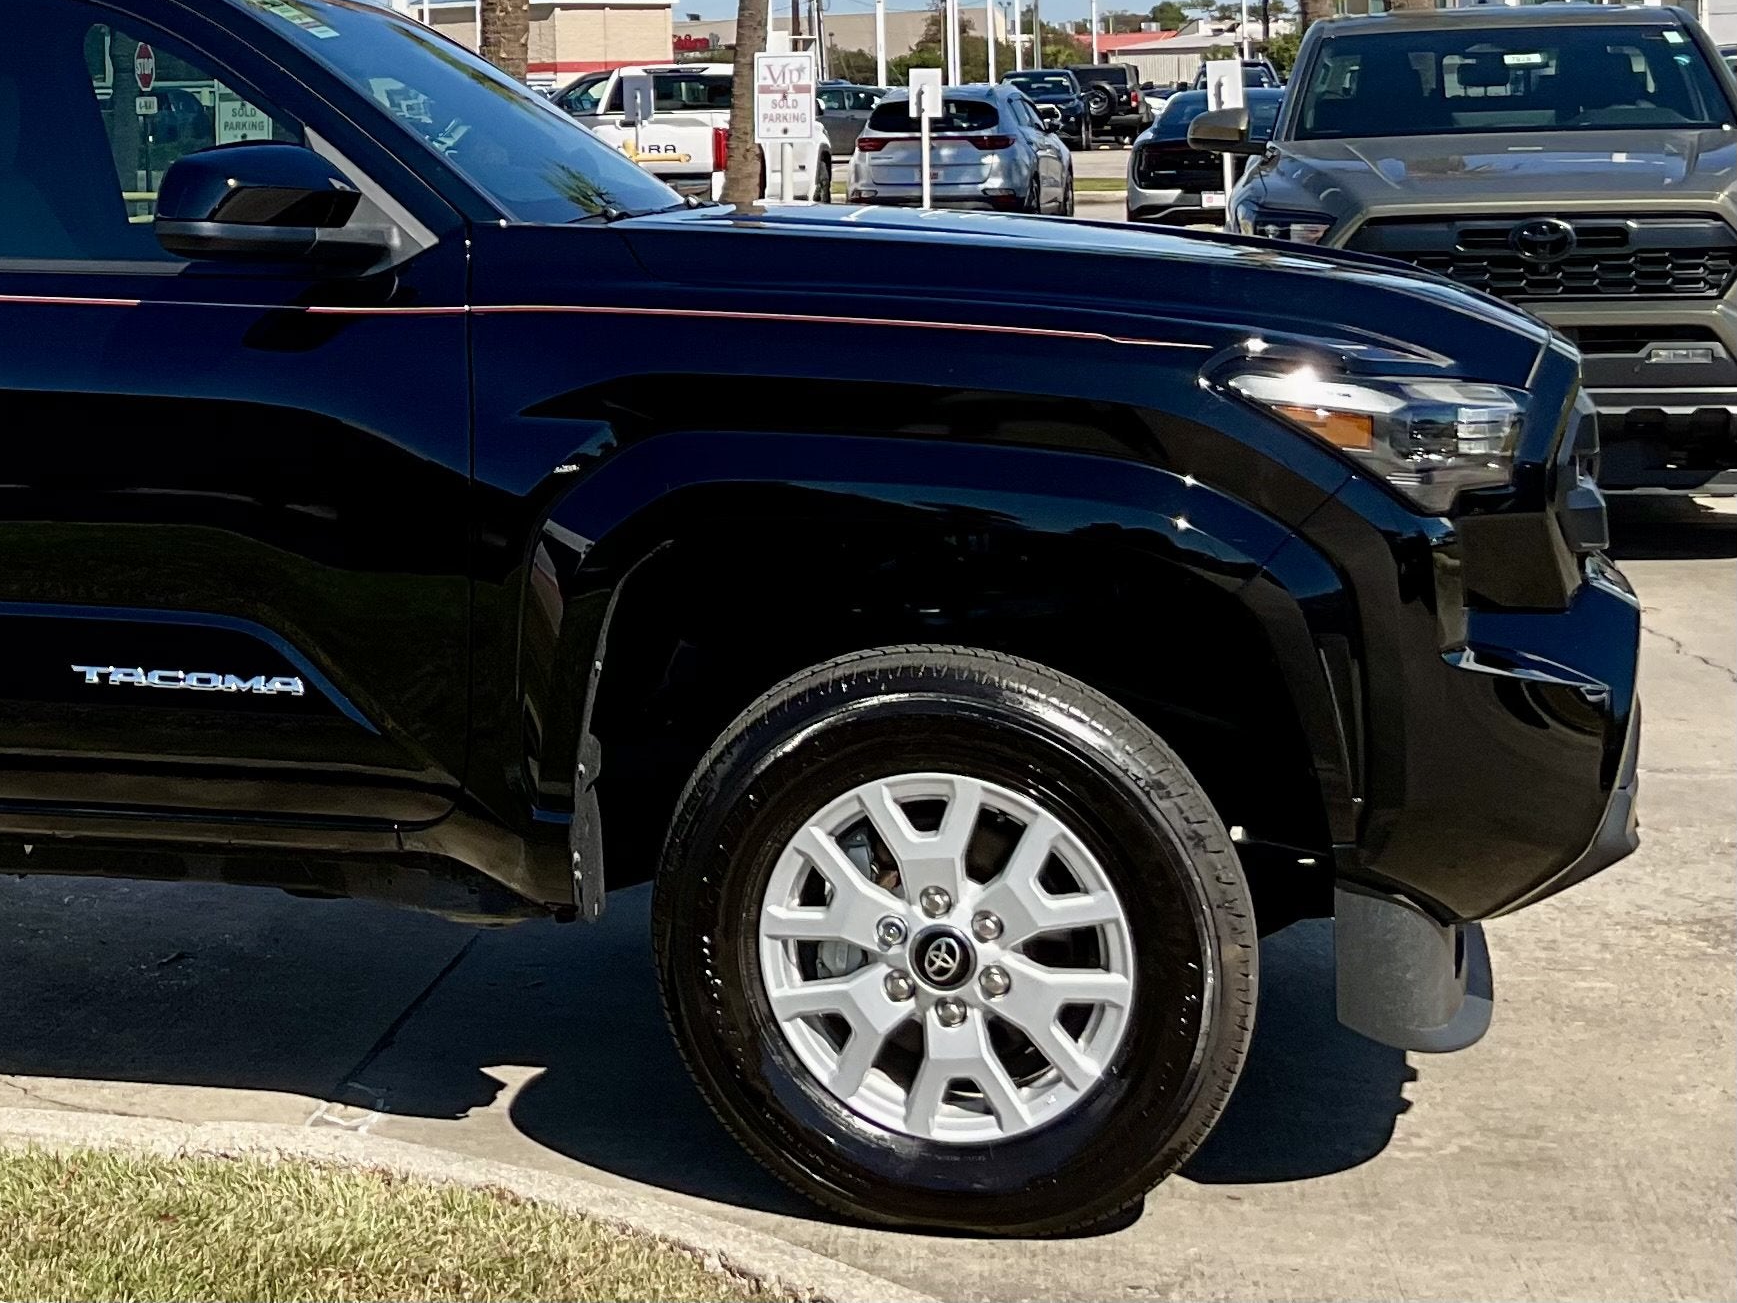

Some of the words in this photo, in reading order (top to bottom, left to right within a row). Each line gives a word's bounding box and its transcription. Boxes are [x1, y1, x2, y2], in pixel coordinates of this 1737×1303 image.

[136, 58, 153, 75] STOP
[771, 98, 799, 110] SOLD
[231, 107, 257, 118] SOLD
[762, 112, 807, 123] PARKING
[223, 120, 265, 131] PARKING
[70, 664, 305, 697] TACOMA
